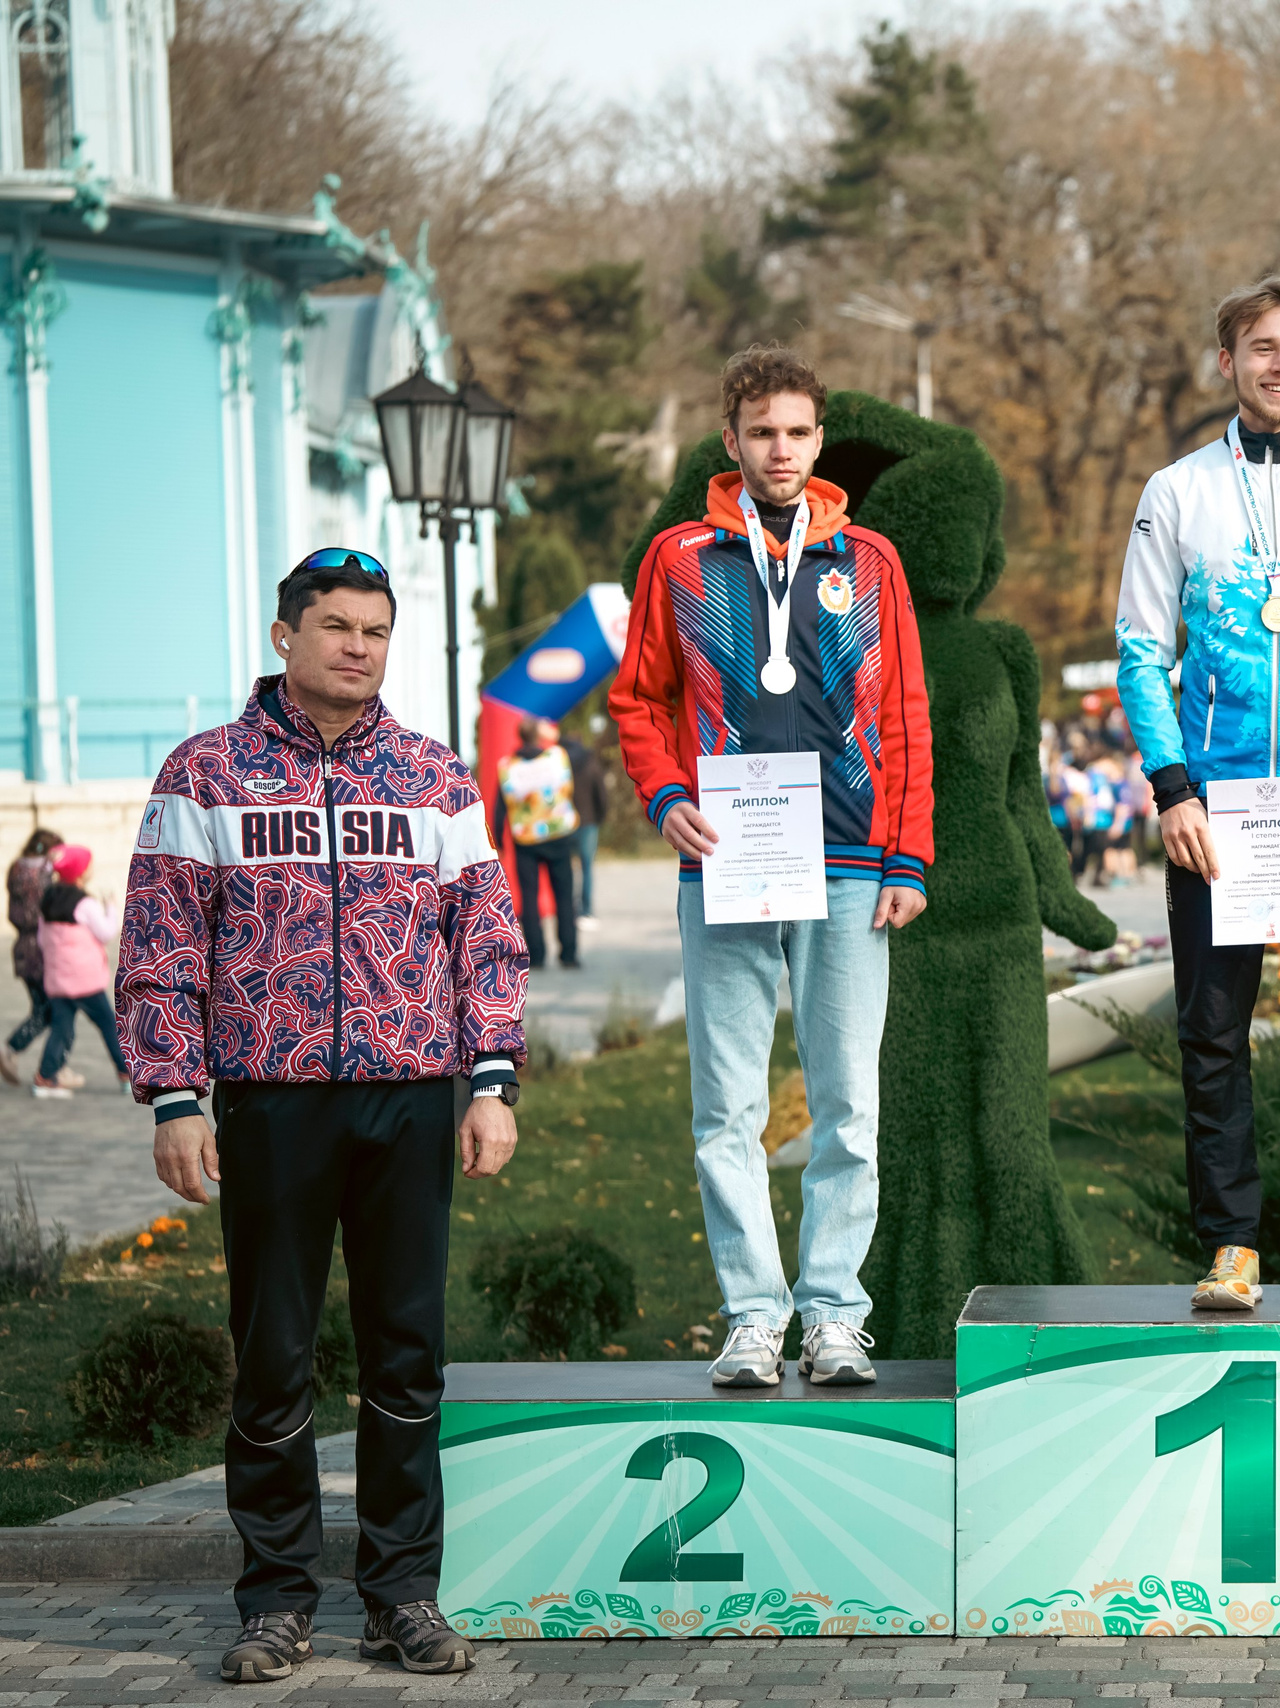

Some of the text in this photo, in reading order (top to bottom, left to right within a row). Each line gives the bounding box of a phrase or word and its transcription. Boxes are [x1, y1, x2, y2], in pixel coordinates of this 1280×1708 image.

[1241, 467, 1256, 508] МИНИСТЕРСТВО
[1253, 509, 1263, 531] СПОРТА
[1260, 532, 1270, 556] РОССИИ
[253, 781, 276, 791] BOSCO
[732, 796, 789, 809] ДИПЛОМ
[241, 810, 415, 859] RUSSIA
[620, 1431, 745, 1582] 2
[1155, 1361, 1276, 1583] 1
